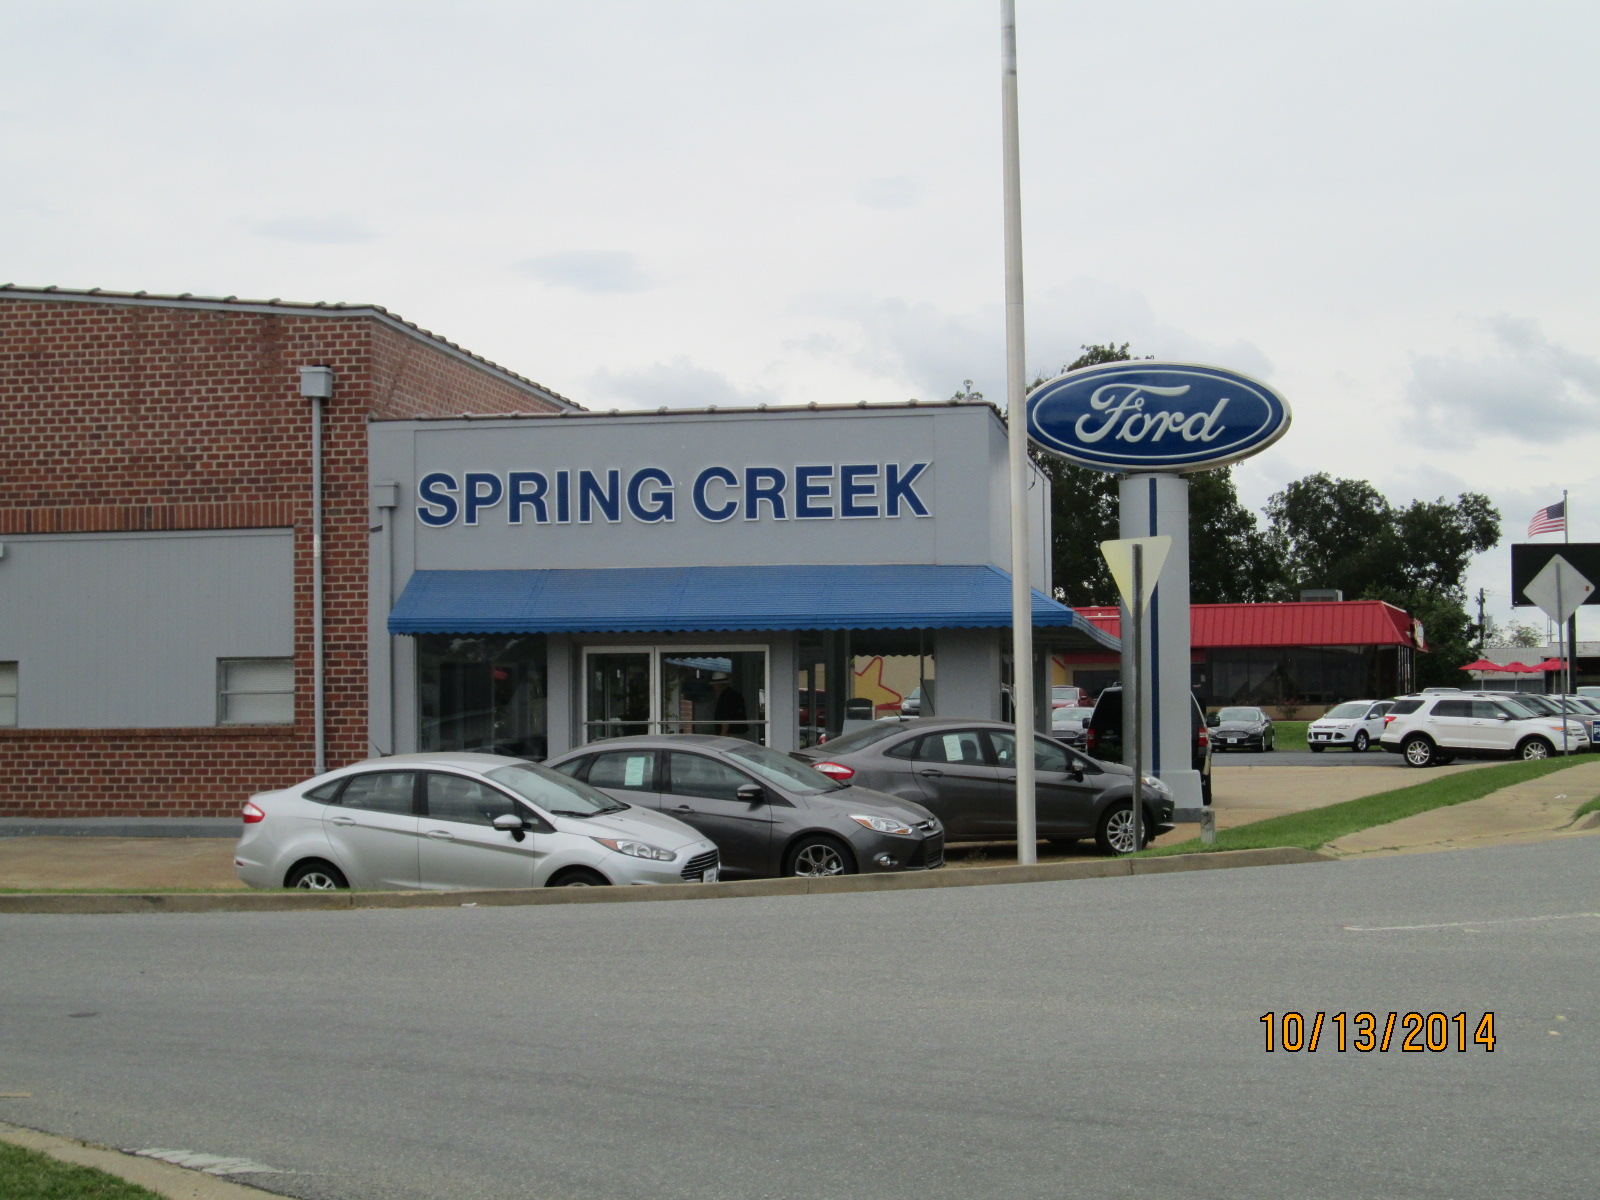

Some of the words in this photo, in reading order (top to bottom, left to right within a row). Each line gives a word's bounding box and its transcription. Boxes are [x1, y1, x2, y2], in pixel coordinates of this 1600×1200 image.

[1075, 383, 1230, 443] Ford
[416, 467, 676, 528] SPRING
[692, 461, 934, 523] CREEK
